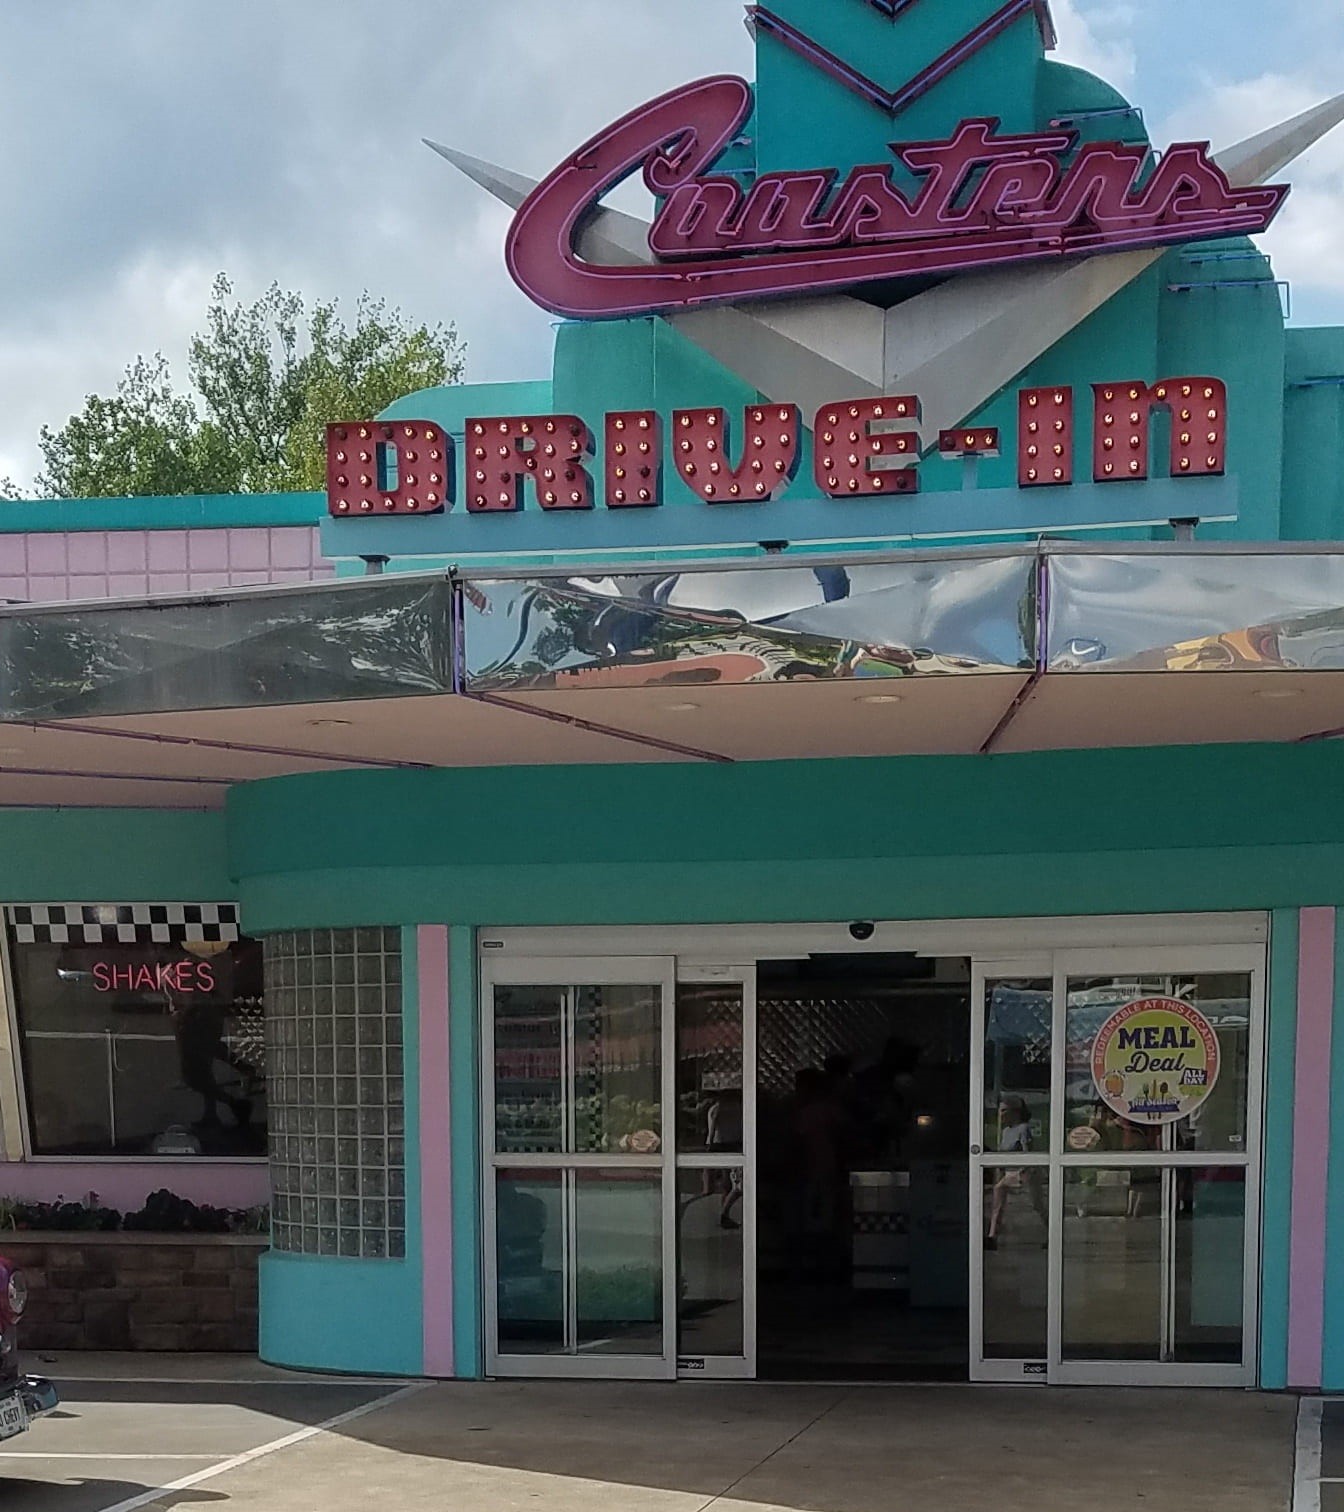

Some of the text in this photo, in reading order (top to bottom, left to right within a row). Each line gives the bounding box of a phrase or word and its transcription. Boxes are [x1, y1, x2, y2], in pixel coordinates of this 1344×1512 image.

[504, 74, 1290, 317] Coasters
[92, 961, 215, 992] SHAKES
[1143, 1000, 1157, 1010] AT
[1161, 1000, 1185, 1014] THIS
[1118, 1026, 1196, 1050] MEAL
[1124, 1050, 1186, 1073] Deal
[1184, 1069, 1206, 1078] ALL
